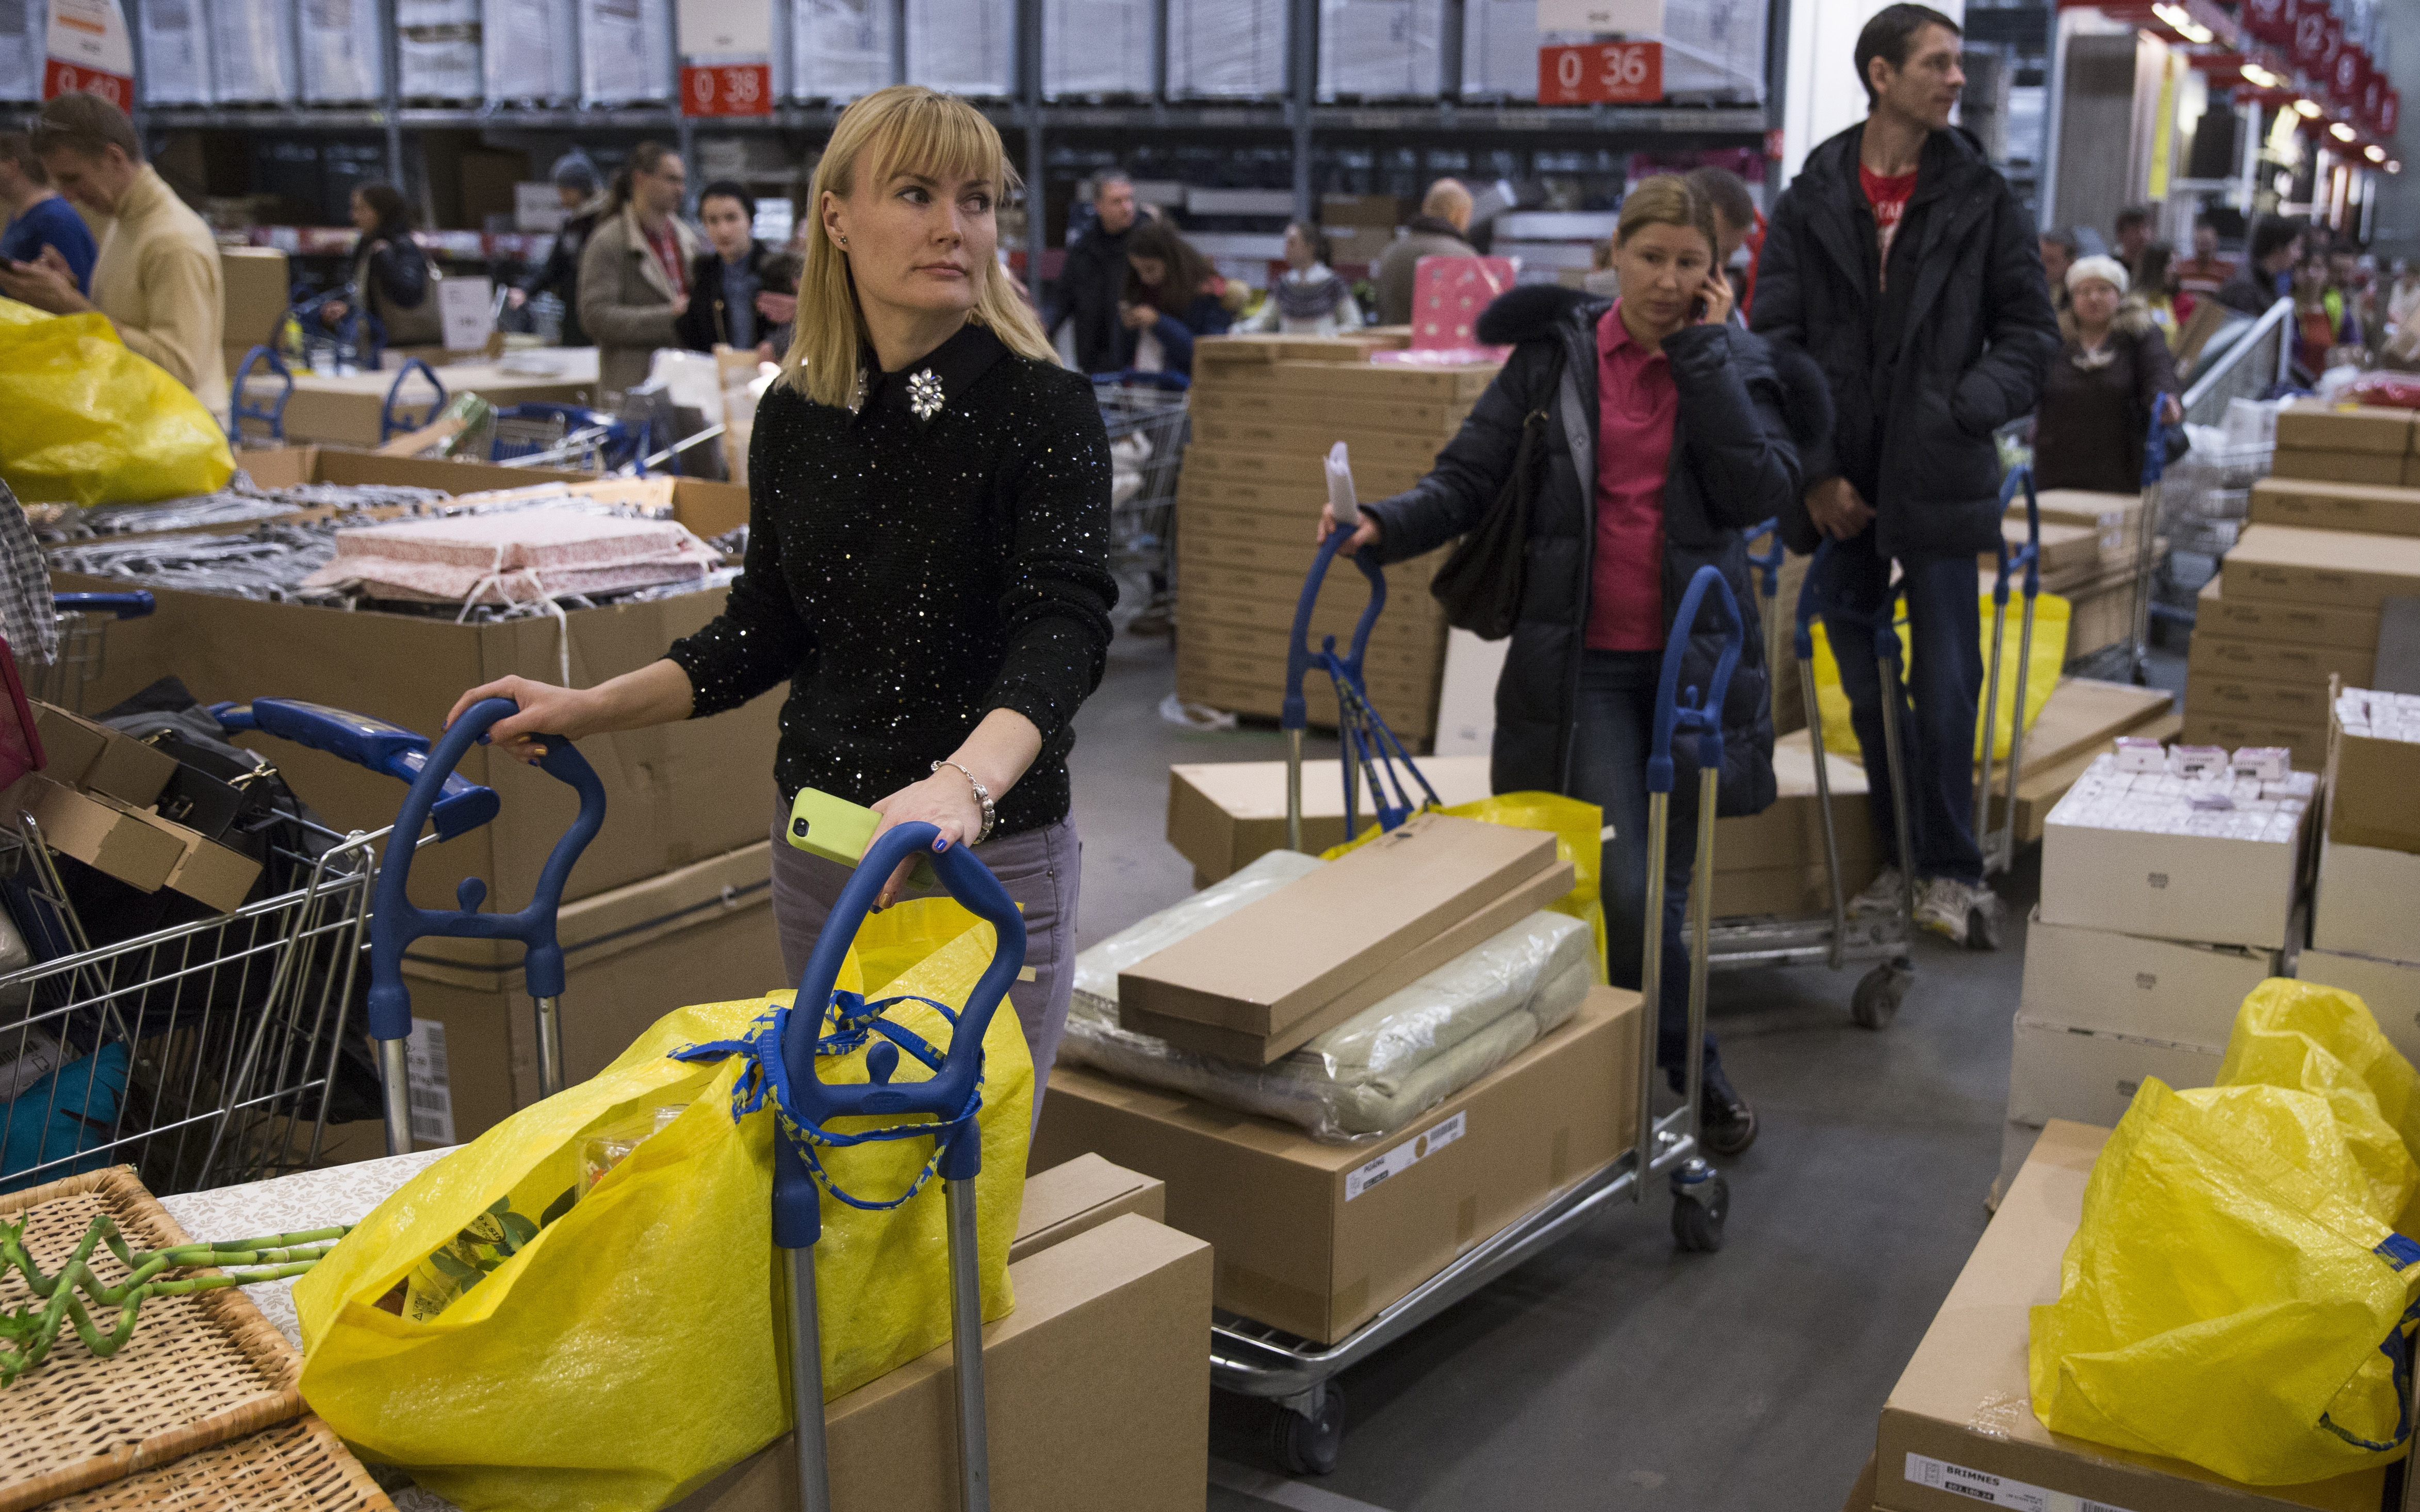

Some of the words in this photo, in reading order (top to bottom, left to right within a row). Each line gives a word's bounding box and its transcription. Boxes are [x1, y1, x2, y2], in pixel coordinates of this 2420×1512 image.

[694, 68, 715, 104] 0
[723, 67, 760, 103] 38
[1558, 50, 1582, 88] 0
[1599, 46, 1647, 85] 36
[1947, 1466, 2000, 1486] BRIMNES
